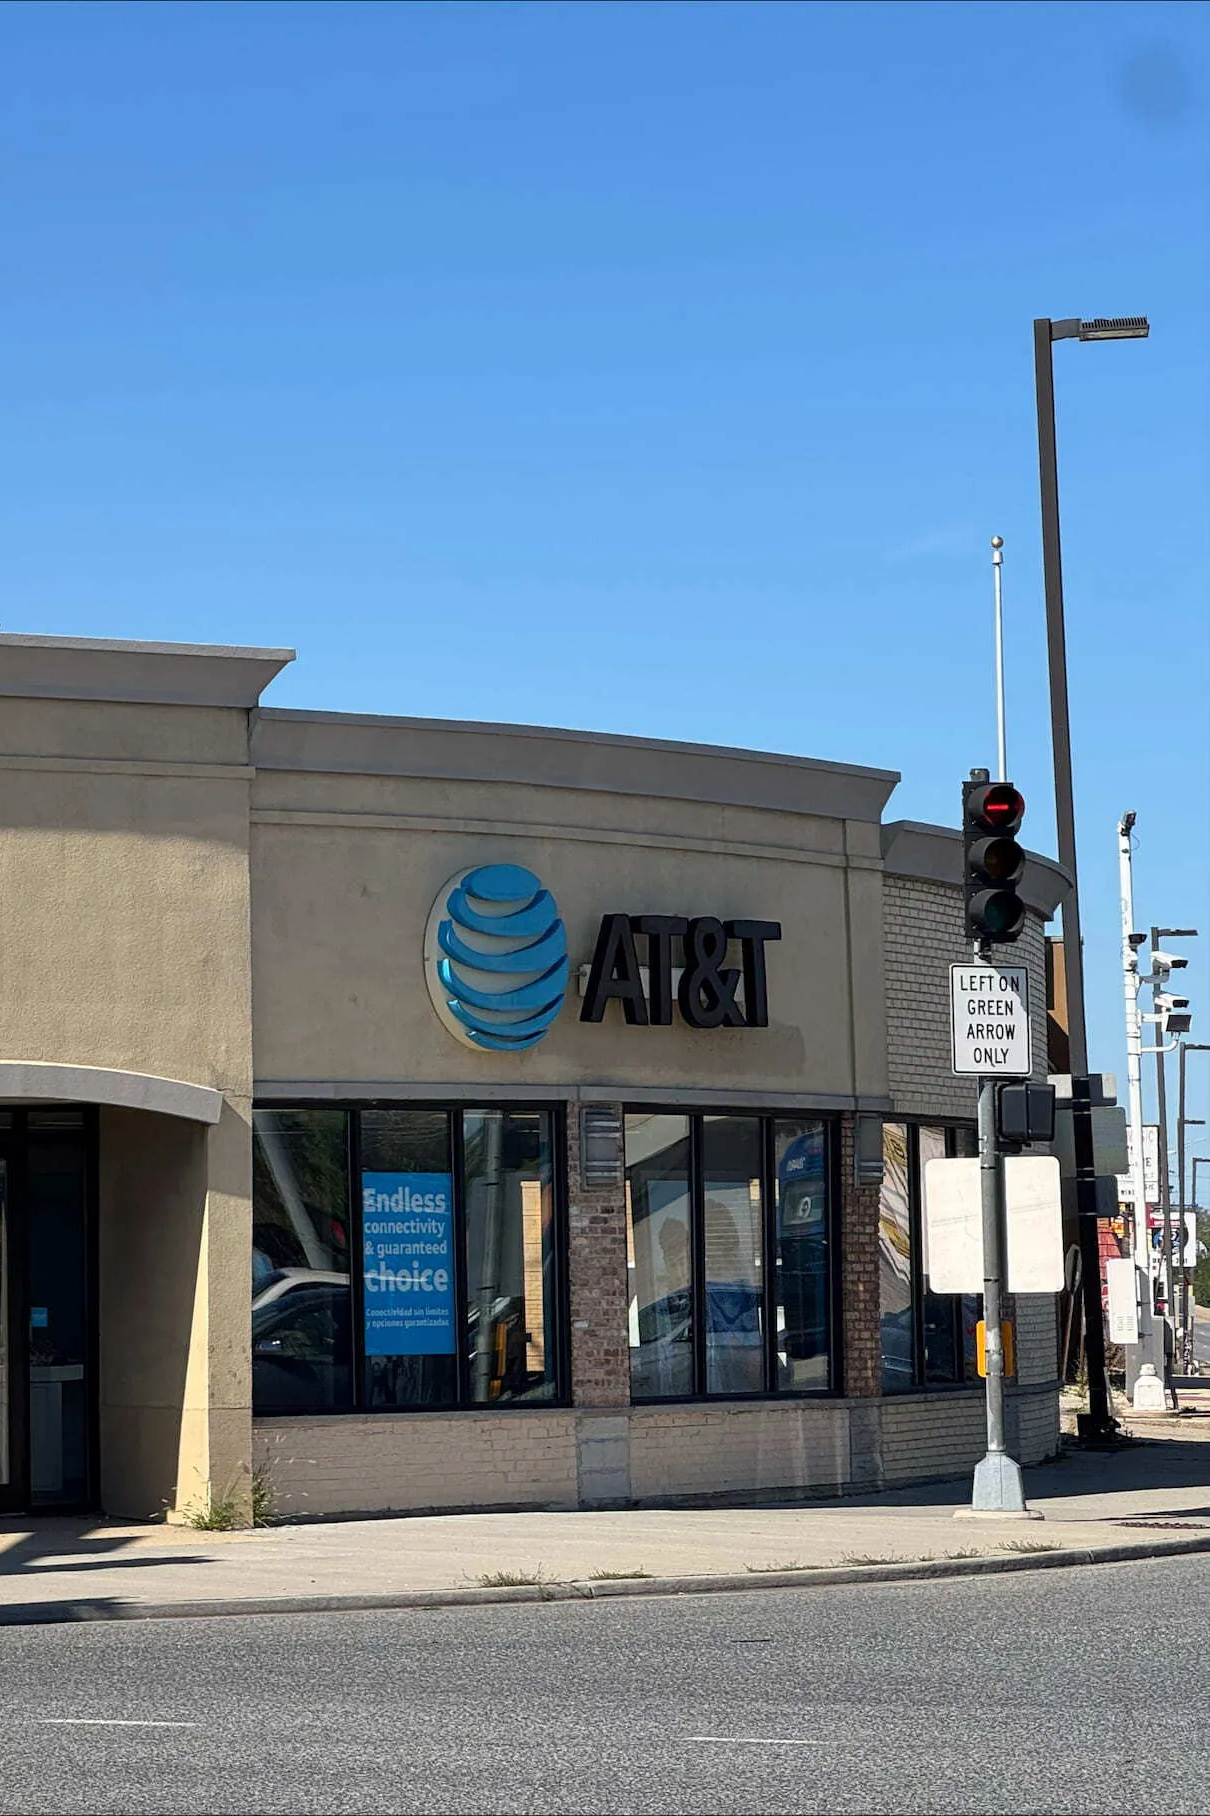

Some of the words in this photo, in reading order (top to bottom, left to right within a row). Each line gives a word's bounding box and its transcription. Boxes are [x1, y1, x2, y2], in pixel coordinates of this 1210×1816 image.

[579, 913, 782, 1028] AT&T
[960, 974, 994, 992] LEFT
[998, 975, 1020, 992] ON
[967, 999, 1014, 1016] GREEN
[966, 1023, 1016, 1040] ARROW
[973, 1047, 1009, 1066] ONLY
[362, 1186, 447, 1213] Endless
[364, 1218, 445, 1237] connectivity
[364, 1240, 374, 1255] &
[377, 1240, 447, 1259] guaranteed
[364, 1260, 449, 1292] choice
